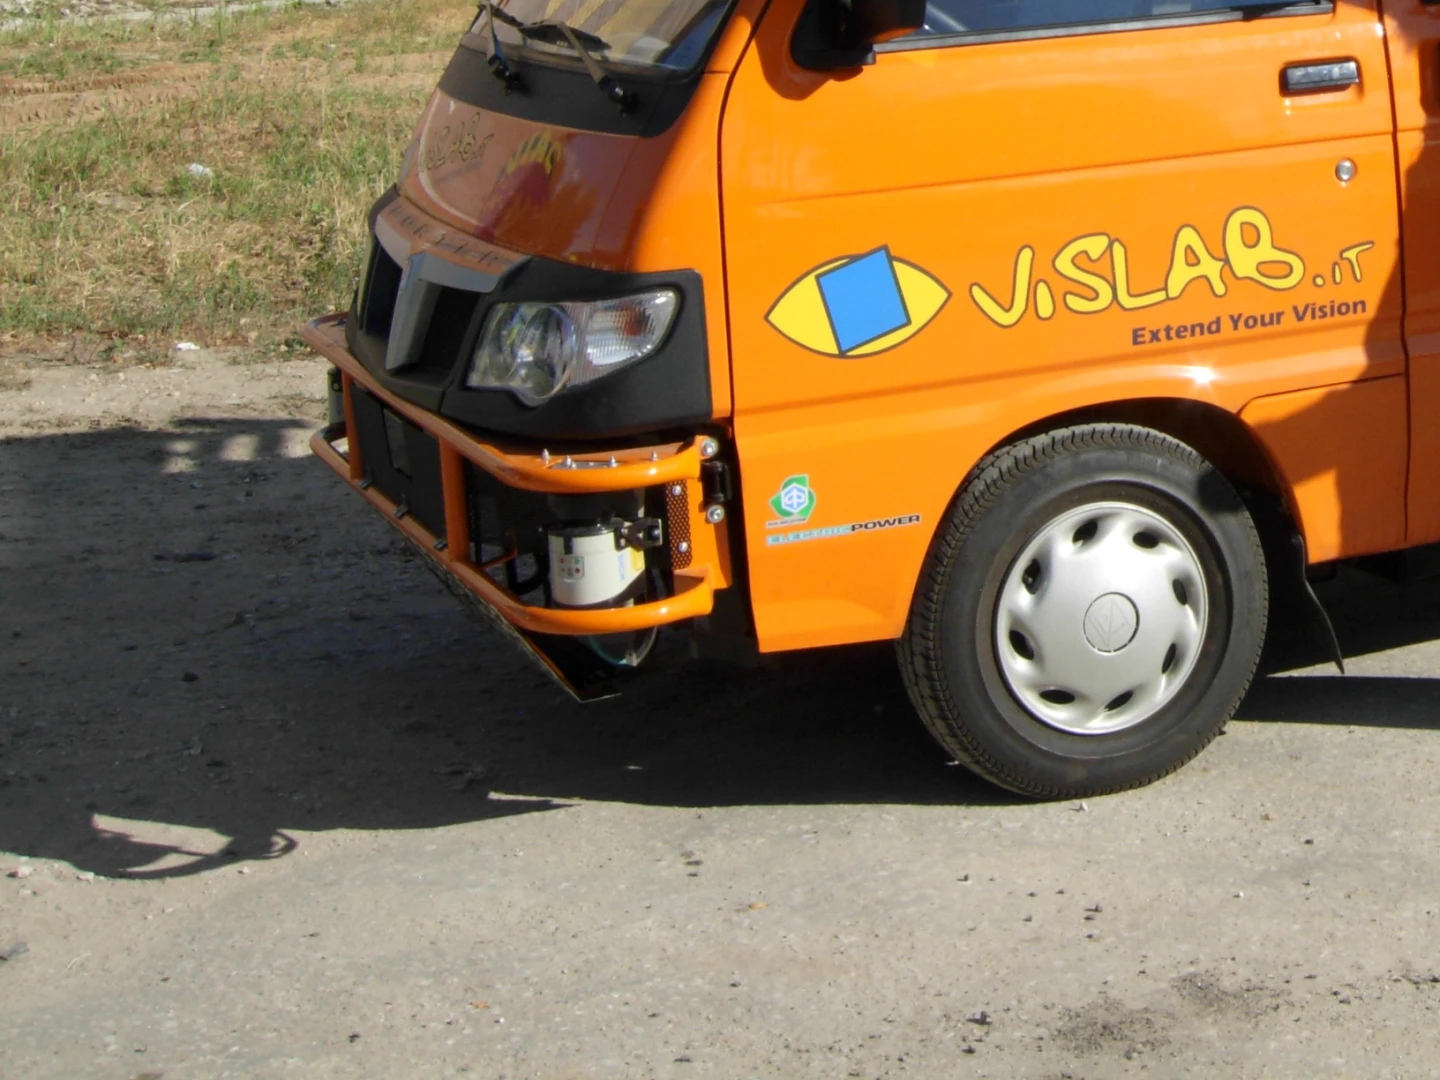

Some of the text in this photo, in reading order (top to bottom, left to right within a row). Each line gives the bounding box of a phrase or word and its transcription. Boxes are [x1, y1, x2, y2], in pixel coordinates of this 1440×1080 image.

[1132, 299, 1367, 346] Extend Your Vision
